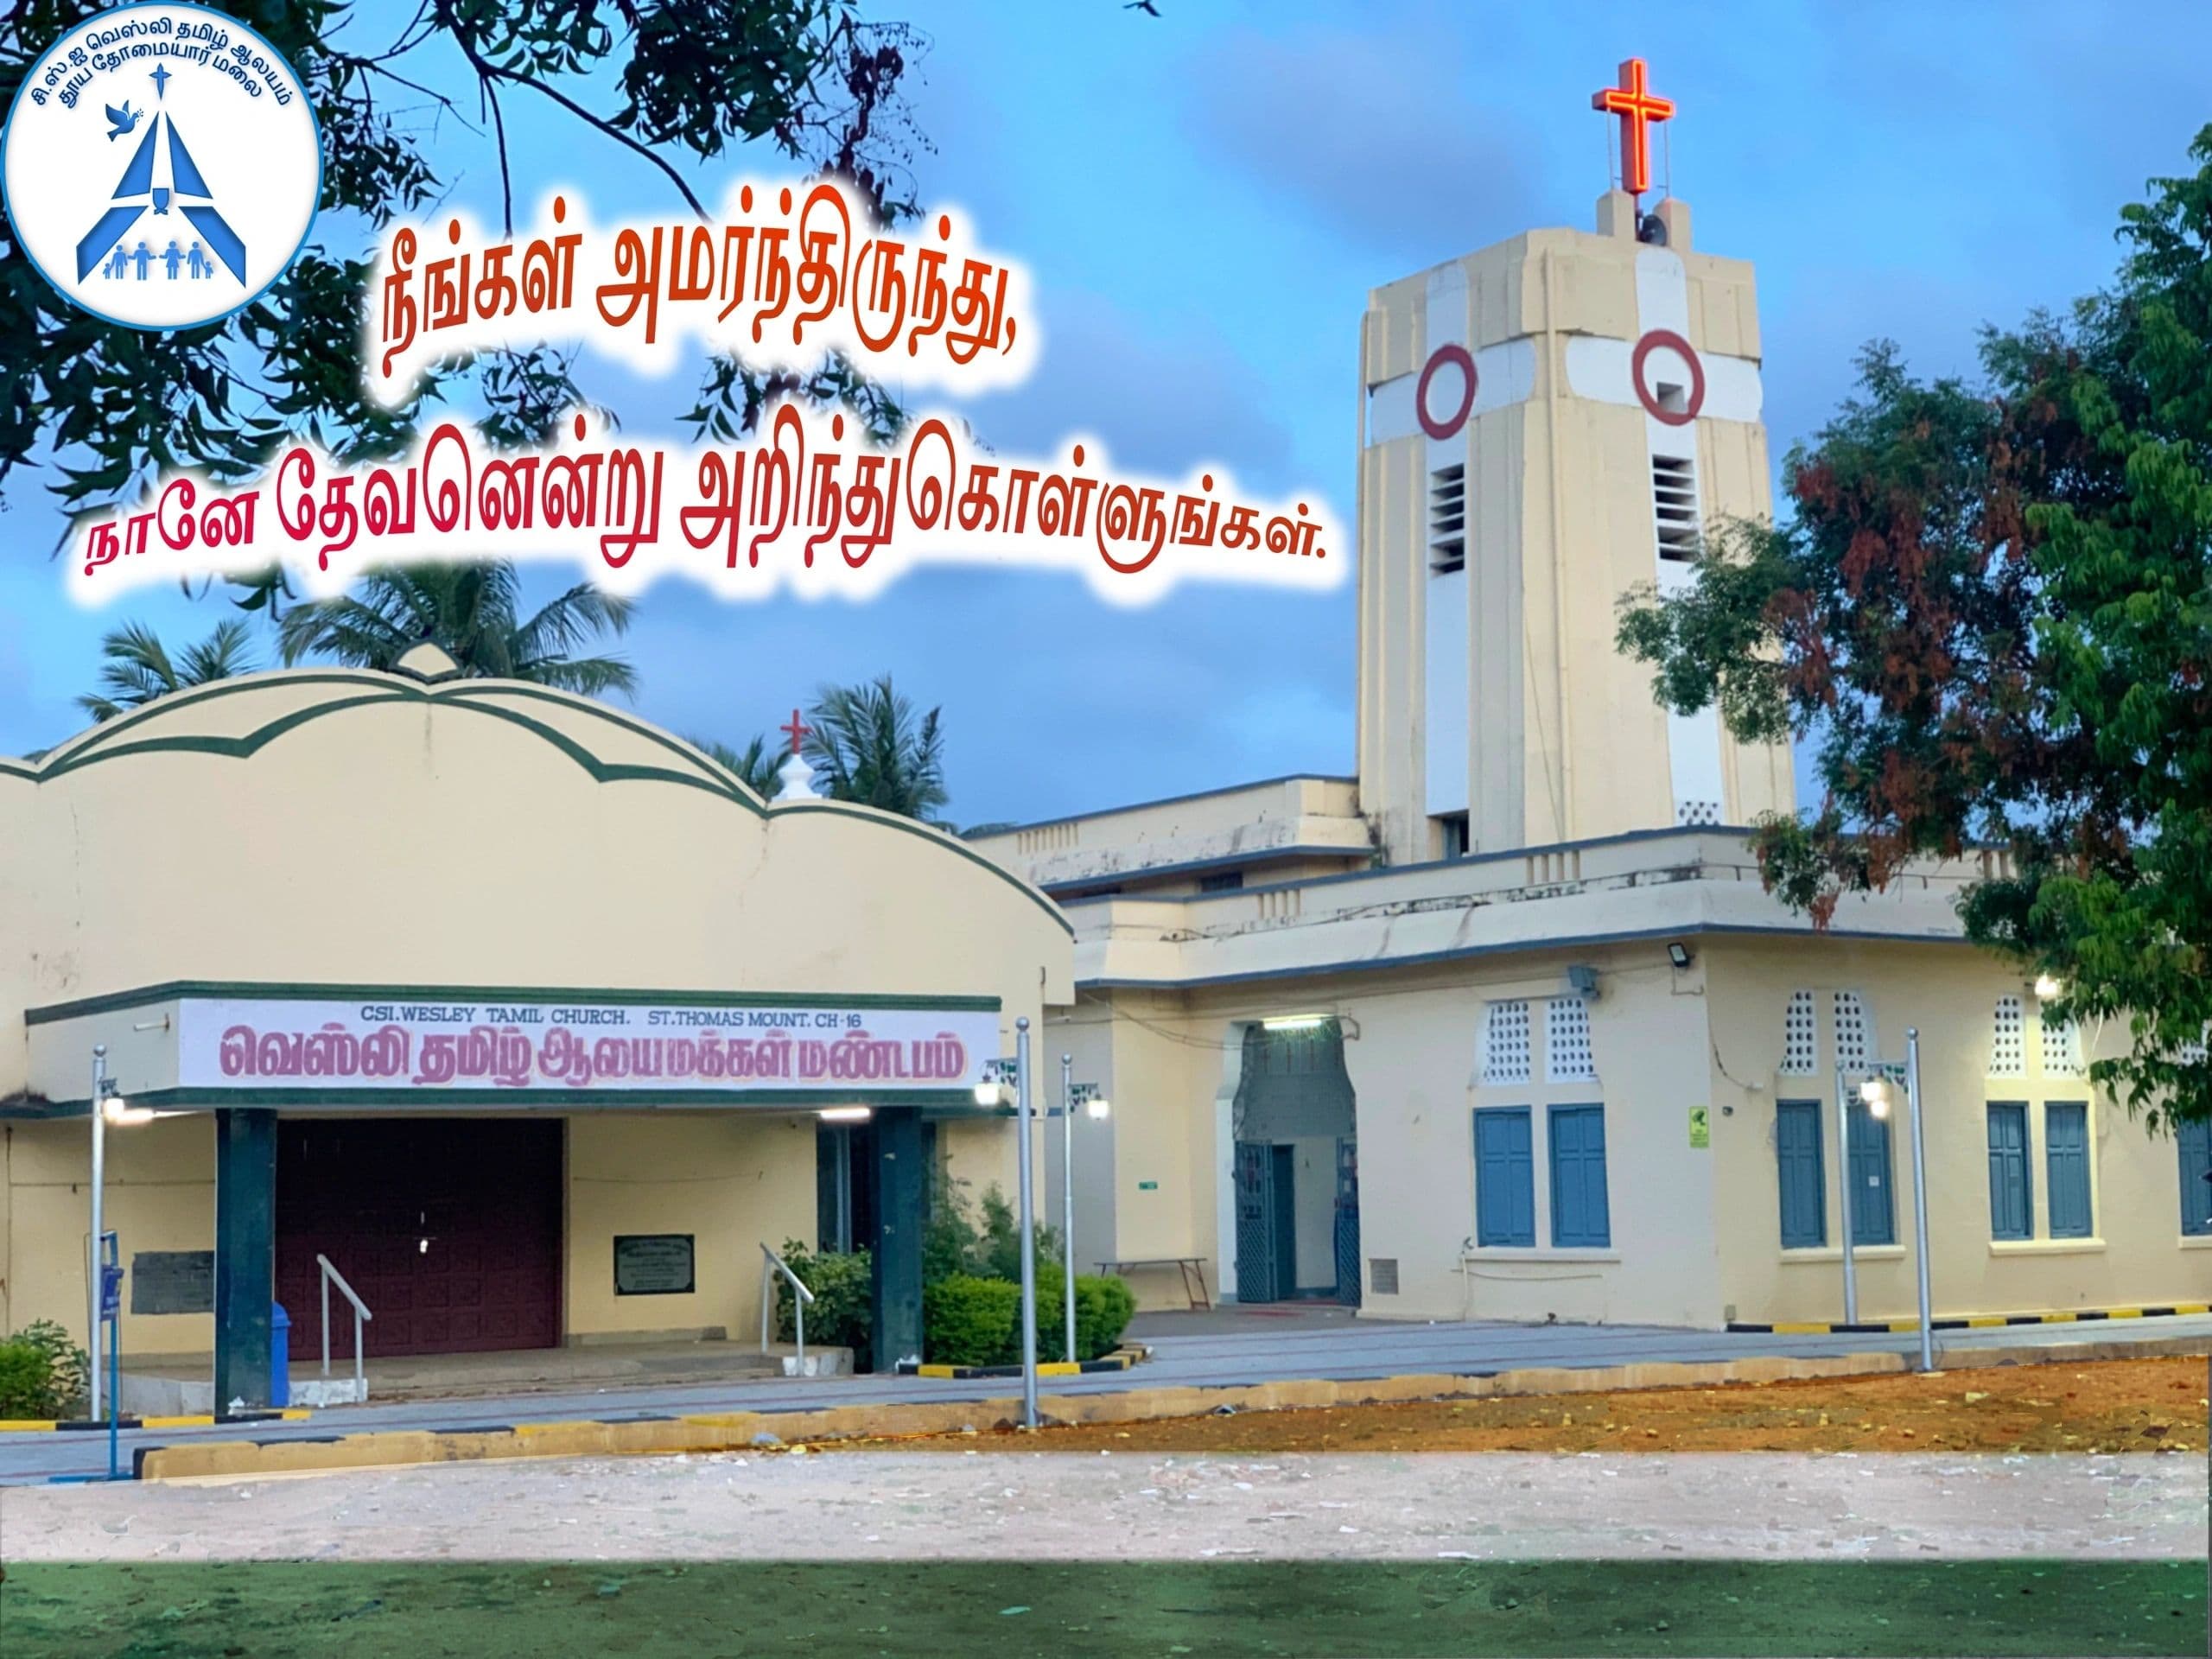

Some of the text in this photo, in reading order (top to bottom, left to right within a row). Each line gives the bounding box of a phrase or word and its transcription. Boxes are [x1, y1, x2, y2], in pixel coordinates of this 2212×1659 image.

[486, 1007, 544, 1023] TAMIL
[550, 1008, 631, 1026] CHURCH.
[748, 1012, 810, 1028] MOUNT.
[219, 1022, 410, 1077] வெஸ்லி
[411, 1025, 532, 1087] தமிழ்
[798, 1029, 966, 1080] மண்டபம்
